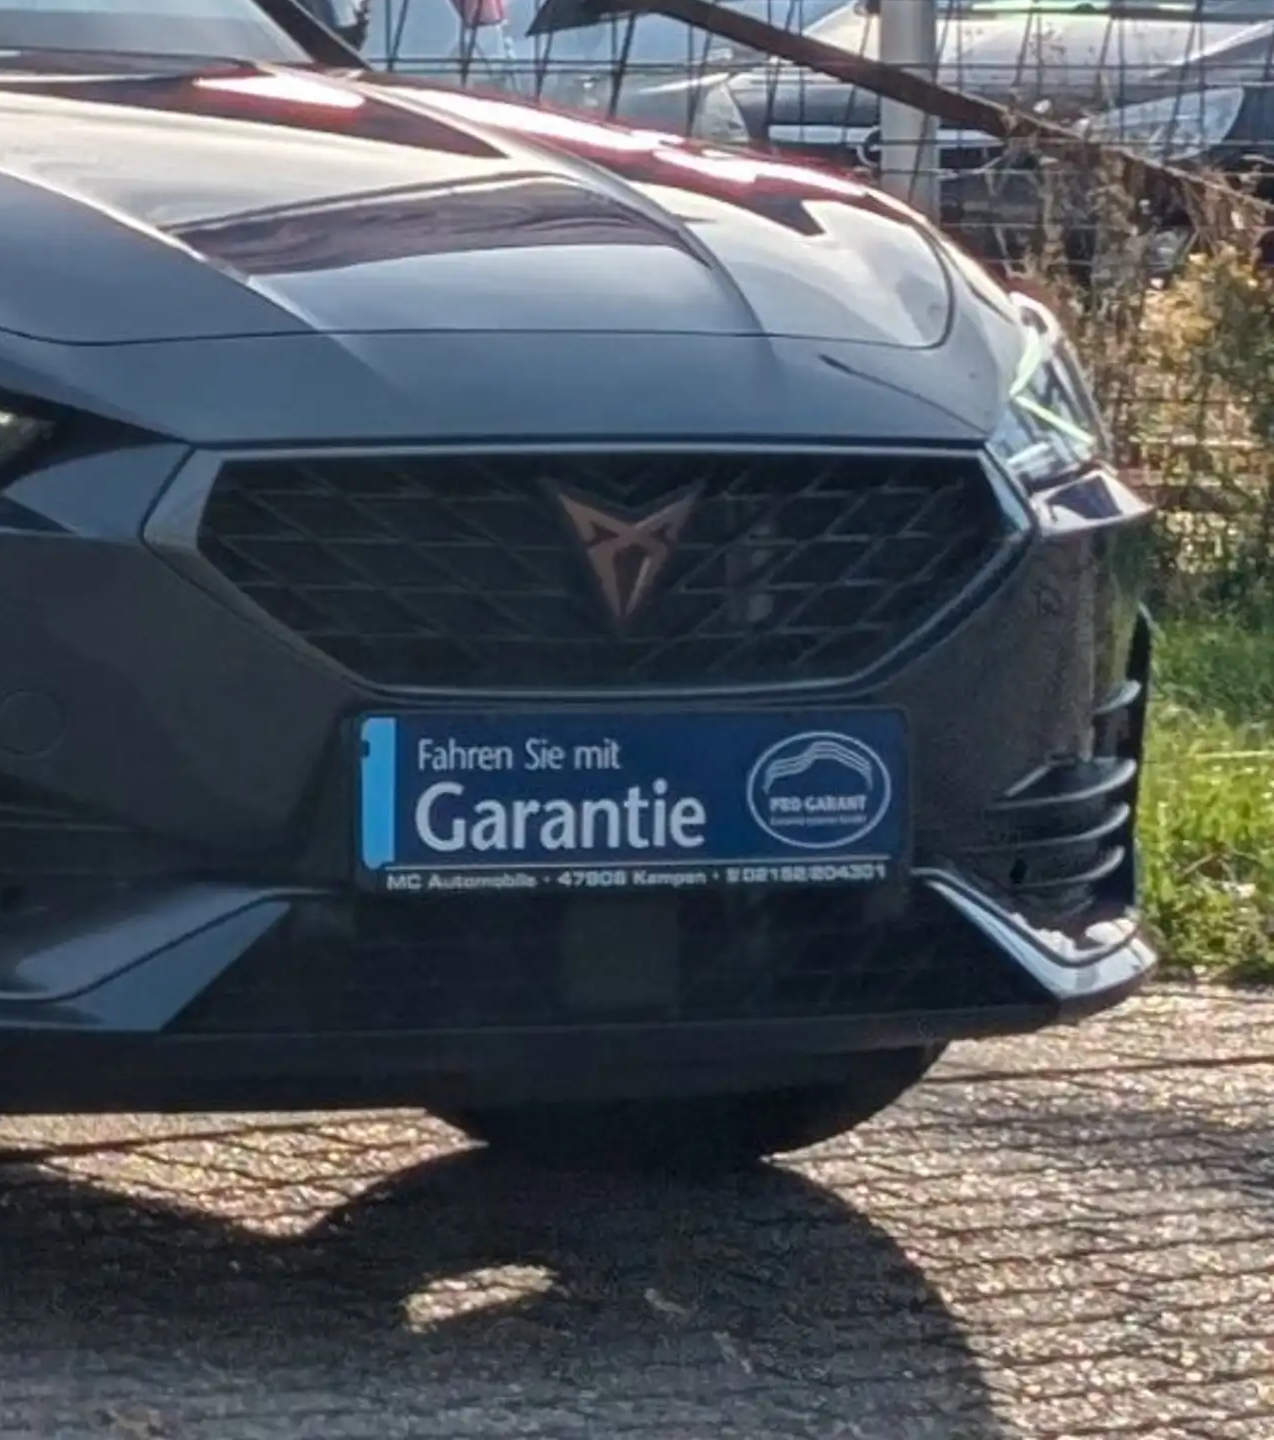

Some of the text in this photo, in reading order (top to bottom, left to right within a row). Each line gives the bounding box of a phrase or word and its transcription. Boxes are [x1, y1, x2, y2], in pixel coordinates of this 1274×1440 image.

[418, 737, 622, 770] Fahren Sie mit
[415, 778, 706, 852] Garantie
[387, 874, 421, 891] MC
